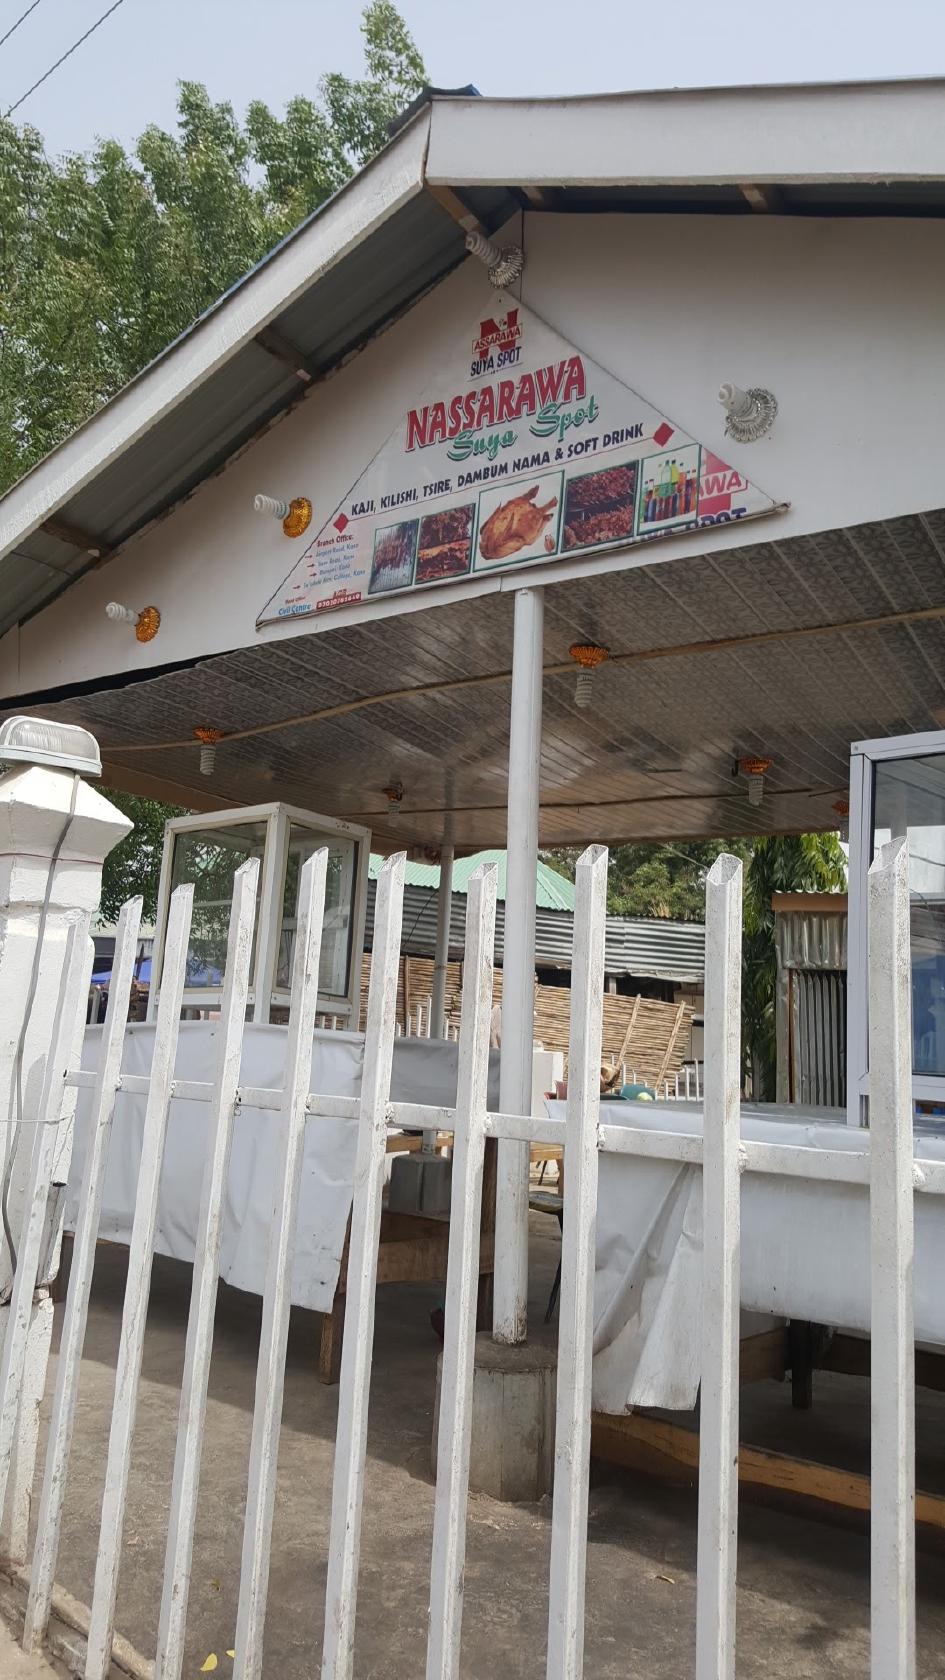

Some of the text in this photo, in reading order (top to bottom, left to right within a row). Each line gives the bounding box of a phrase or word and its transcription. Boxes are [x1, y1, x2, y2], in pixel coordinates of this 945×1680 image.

[470, 346, 522, 377] SUYA SPOT
[405, 355, 587, 453] NASSARAWA
[447, 395, 600, 461] Suya Spot
[351, 422, 644, 516] KAJI, KILISHI, TSIRE, DAMBUM NAMA & SOFT DRINK
